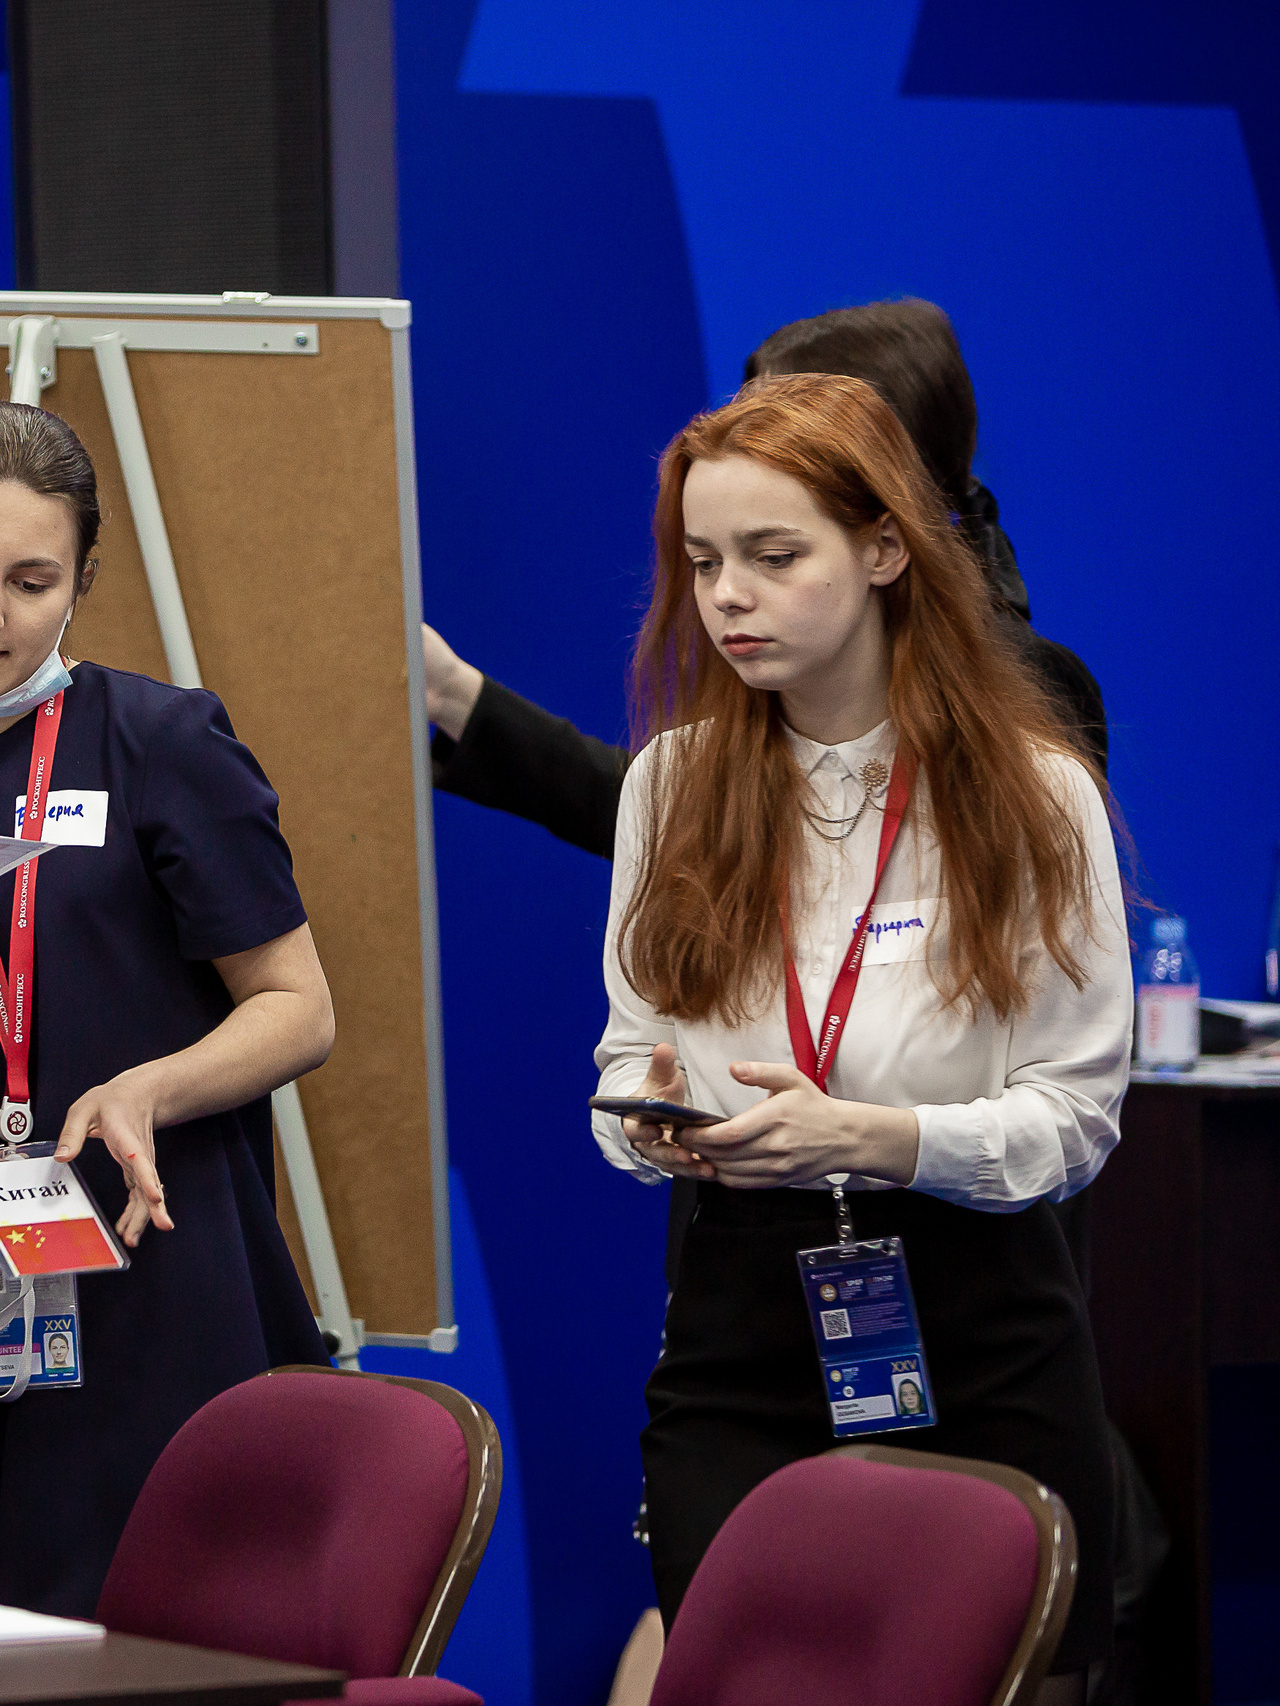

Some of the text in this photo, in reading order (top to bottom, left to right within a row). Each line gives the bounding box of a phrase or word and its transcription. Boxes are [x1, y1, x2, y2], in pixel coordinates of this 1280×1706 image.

[31, 755, 46, 810] РОСКОНГРЕСС
[16, 803, 85, 827] Верия
[16, 973, 24, 1033] РОСКОНГРЕСС
[44, 1318, 72, 1331] XXV
[889, 1359, 918, 1373] XXV
